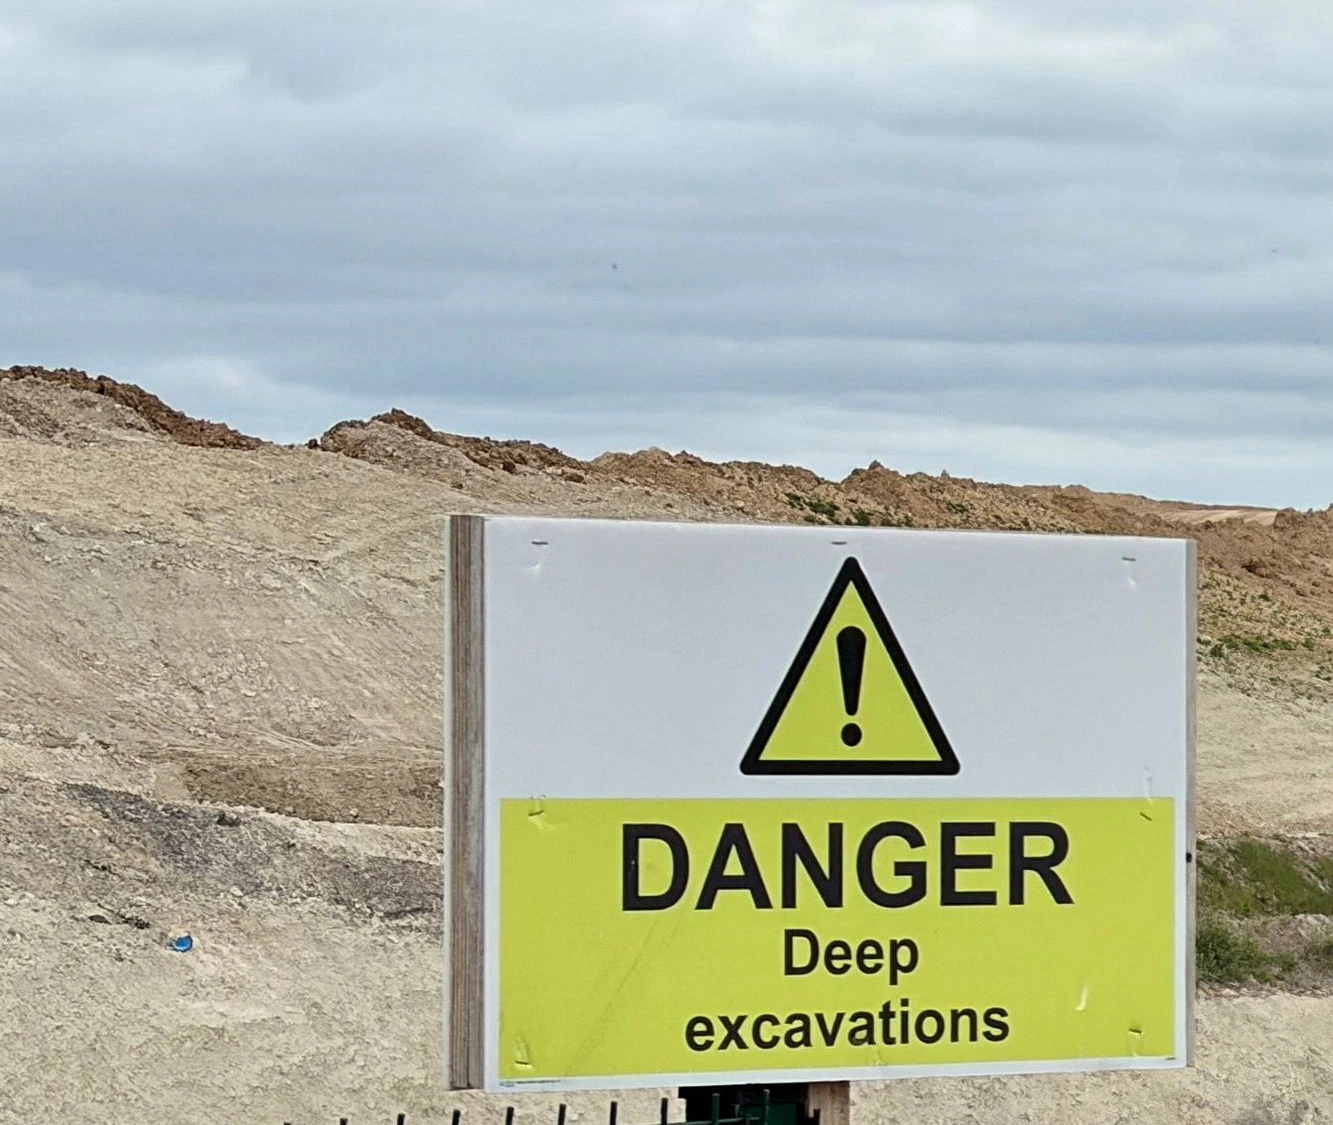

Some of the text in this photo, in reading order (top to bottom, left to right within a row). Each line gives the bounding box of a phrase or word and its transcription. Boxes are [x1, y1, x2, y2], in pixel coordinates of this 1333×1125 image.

[622, 820, 1074, 912] DANGER
[784, 929, 919, 986] Deep
[684, 1000, 1010, 1052] excavations
